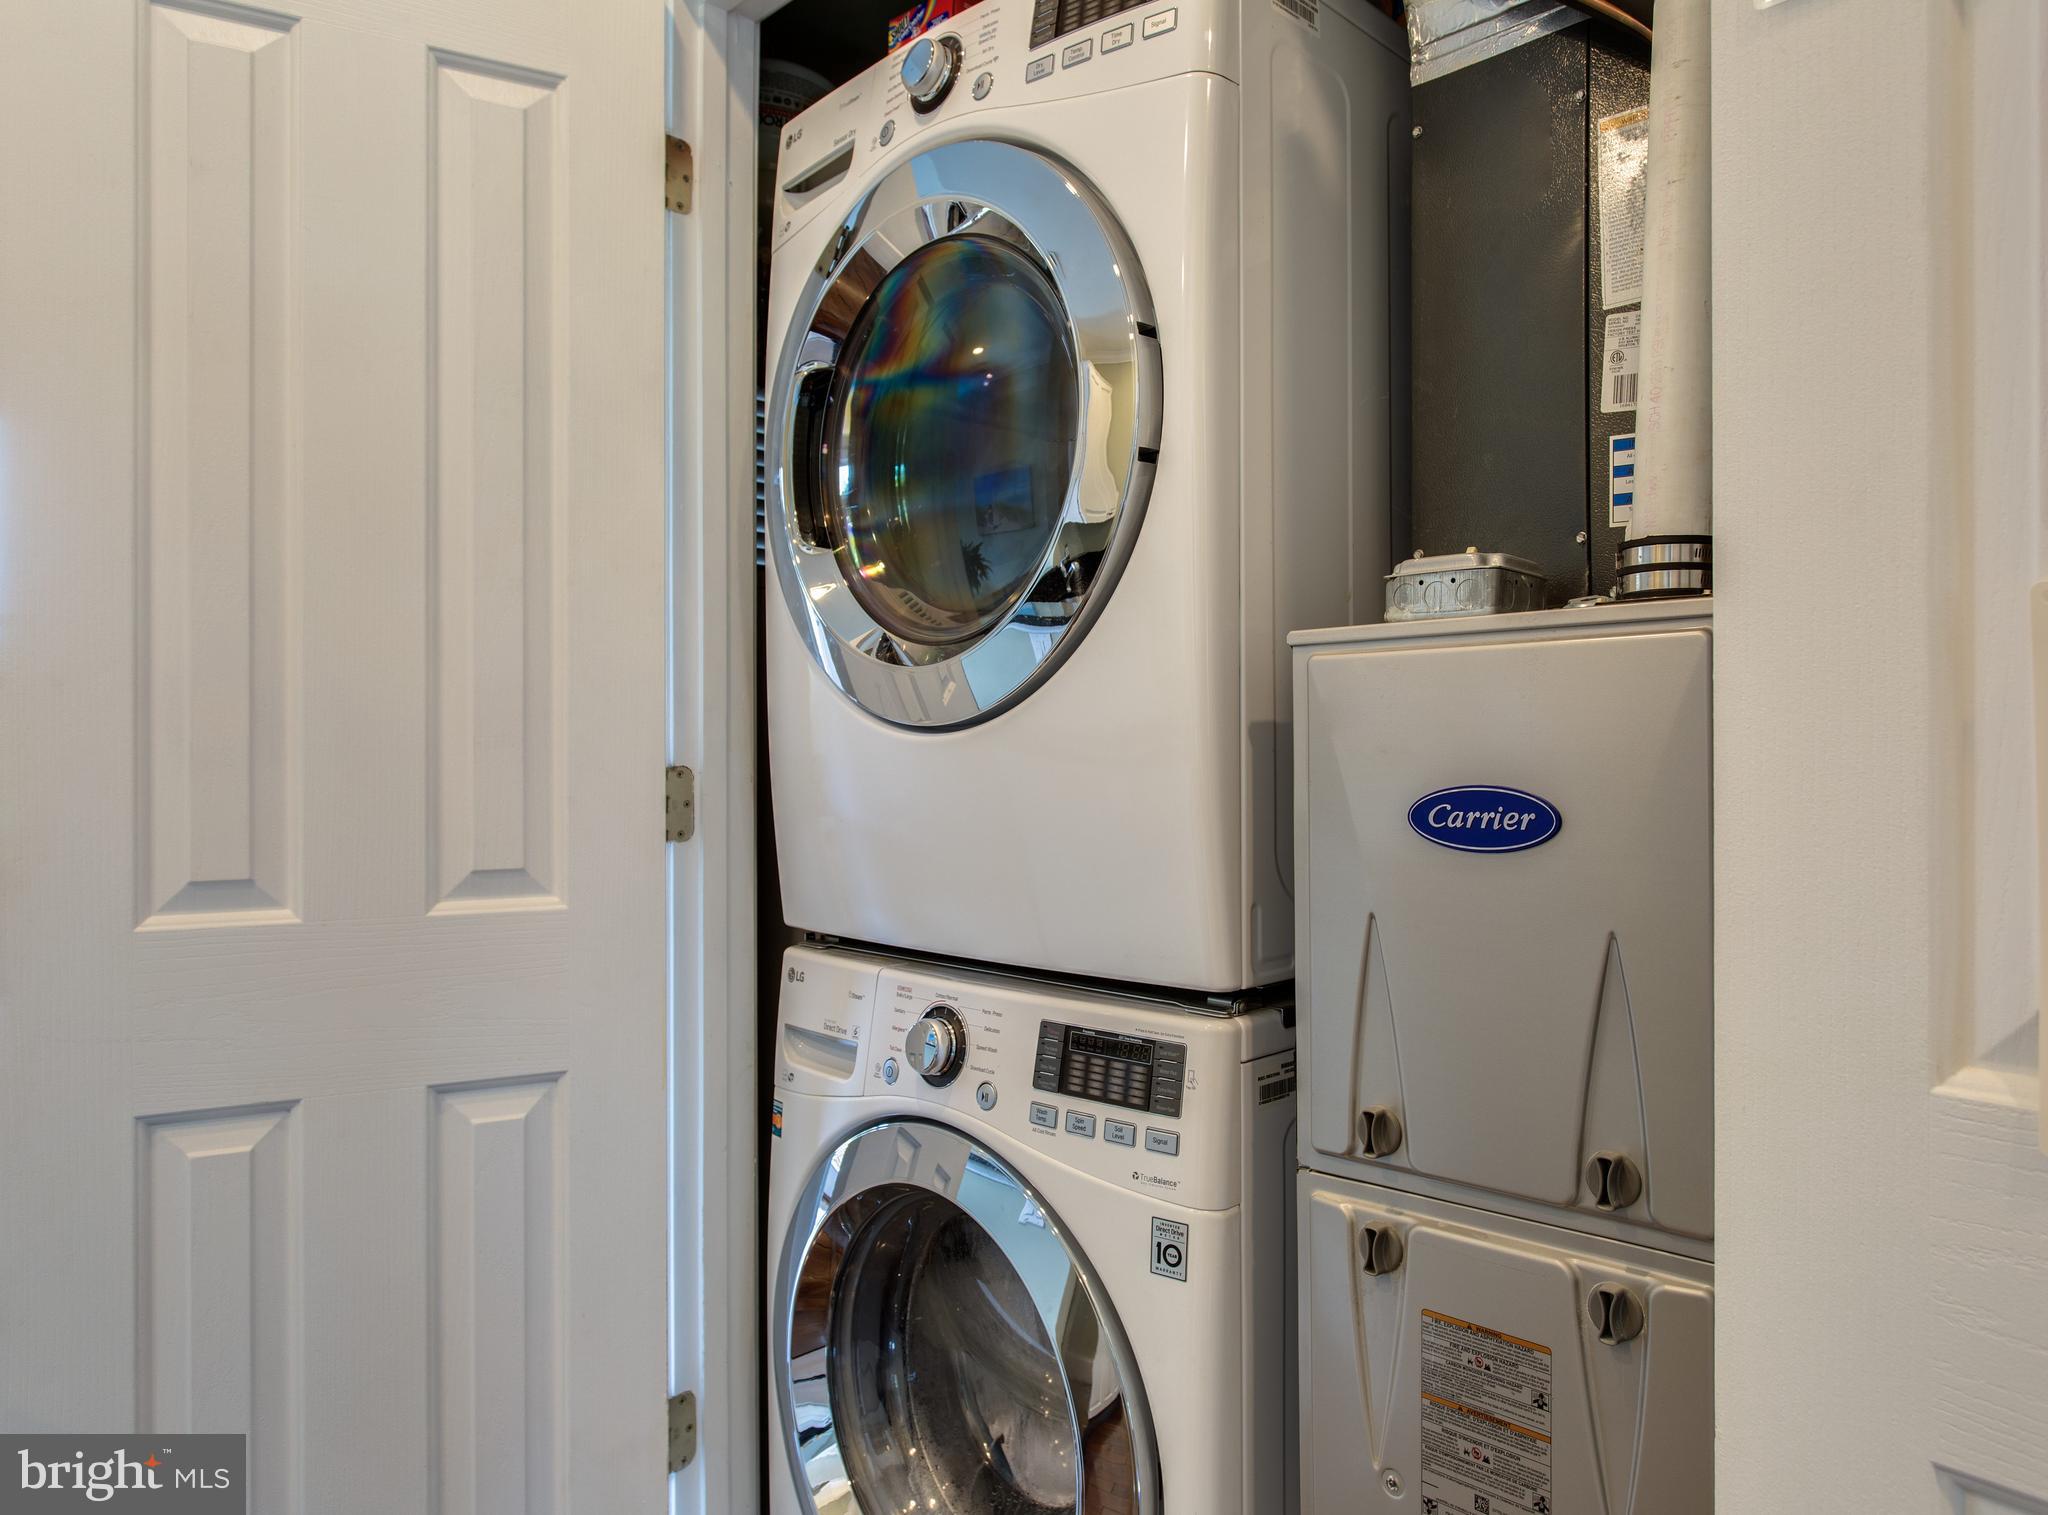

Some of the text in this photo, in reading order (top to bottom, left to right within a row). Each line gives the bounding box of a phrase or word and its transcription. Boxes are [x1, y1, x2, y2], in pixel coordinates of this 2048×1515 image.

[1151, 18, 1167, 28] Signal
[1111, 31, 1123, 39] Time
[1112, 37, 1121, 46] Dry
[1068, 51, 1085, 62] Control
[1035, 62, 1043, 70] Dry
[1033, 68, 1045, 77] Level
[793, 128, 803, 143] LG
[1428, 803, 1536, 830] Carrier
[796, 971, 804, 983] LG
[1072, 1123, 1087, 1132] Speed
[1111, 1133, 1125, 1141] Level
[1152, 1136, 1168, 1146] Signal
[1156, 1225, 1184, 1237] Direct Drive
[1156, 1241, 1182, 1267] 10
[1155, 1266, 1182, 1276] WARRANTY
[1471, 1349, 1498, 1362] EXPLOSION
[1500, 1359, 1518, 1369] HAZARD
[1506, 1380, 1522, 1389] HAZARD
